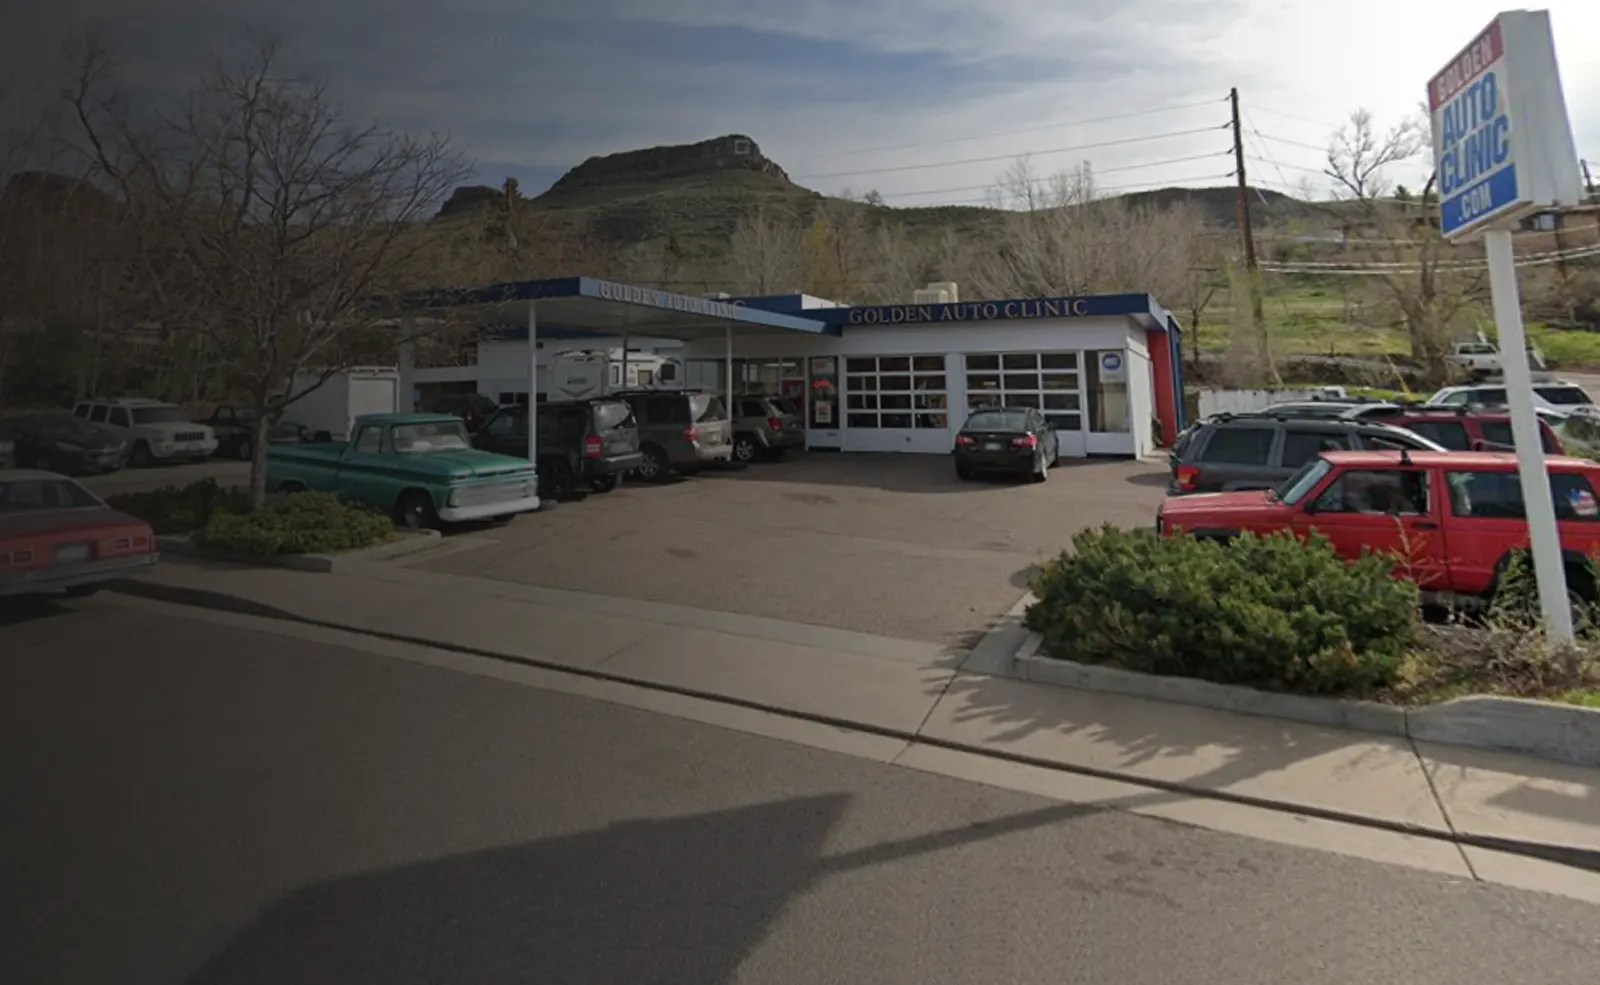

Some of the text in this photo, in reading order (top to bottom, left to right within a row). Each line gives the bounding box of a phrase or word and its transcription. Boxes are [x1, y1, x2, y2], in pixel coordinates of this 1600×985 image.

[1437, 34, 1493, 101] GOLDEN
[1443, 71, 1497, 151] AUTO
[1440, 113, 1510, 195] CLINIC
[1458, 182, 1493, 222] .COM
[849, 300, 1088, 325] GOLDEN AUTO CLINIC
